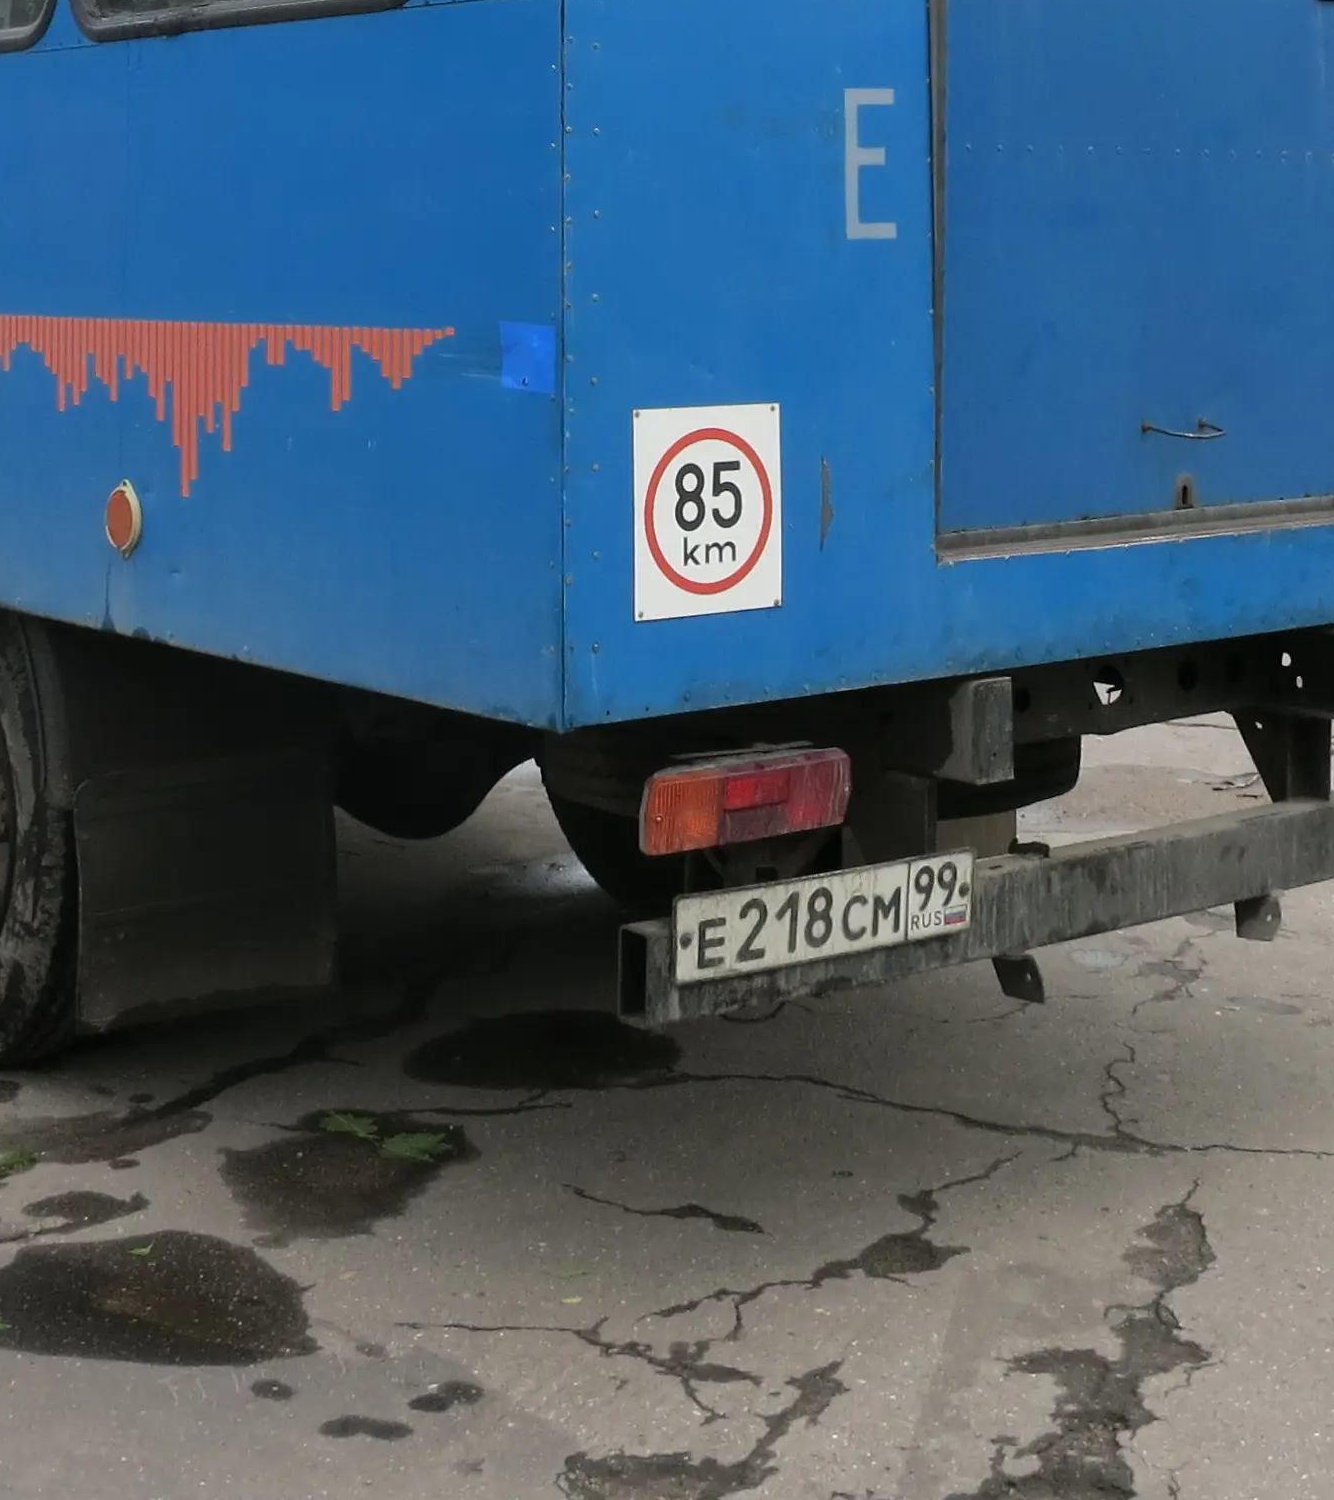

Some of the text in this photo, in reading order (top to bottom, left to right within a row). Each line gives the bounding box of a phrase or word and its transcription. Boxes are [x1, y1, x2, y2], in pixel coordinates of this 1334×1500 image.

[674, 460, 743, 532] 85
[682, 536, 737, 566] km
[914, 861, 958, 911] 99
[910, 910, 942, 930] RUS
